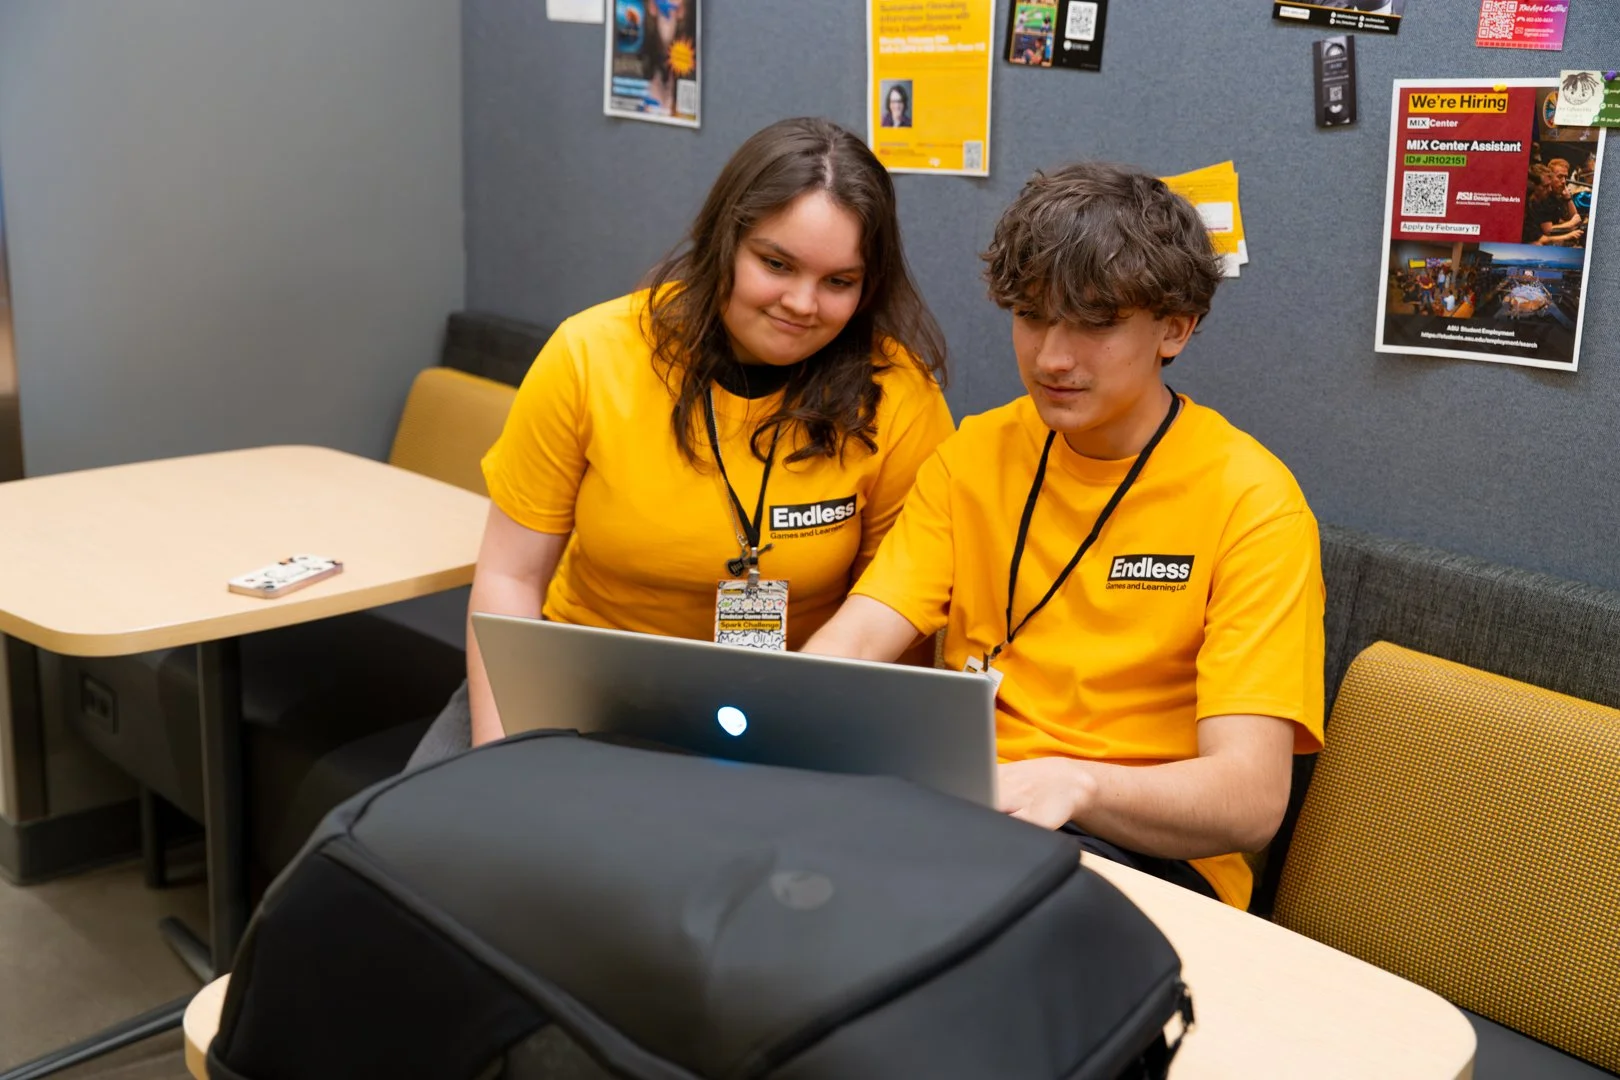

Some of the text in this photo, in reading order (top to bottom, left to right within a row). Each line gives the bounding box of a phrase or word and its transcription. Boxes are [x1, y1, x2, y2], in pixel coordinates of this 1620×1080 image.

[1411, 95, 1507, 112] We're Hiring
[1409, 119, 1459, 127] MIX Center
[1406, 140, 1522, 152] MIX Center Assistant
[1406, 155, 1465, 165] ID# JR102151
[1473, 195, 1491, 203] Design
[1402, 223, 1424, 231] Apply
[1436, 224, 1470, 232] February
[1460, 325, 1482, 334] Student
[1481, 327, 1515, 337] Employment
[773, 502, 855, 528] Endless
[770, 532, 799, 540] Games
[799, 529, 814, 538] and
[1110, 557, 1190, 579] Endless
[1105, 582, 1187, 592] Games and Learning Lab
[743, 621, 779, 629] Challenge
